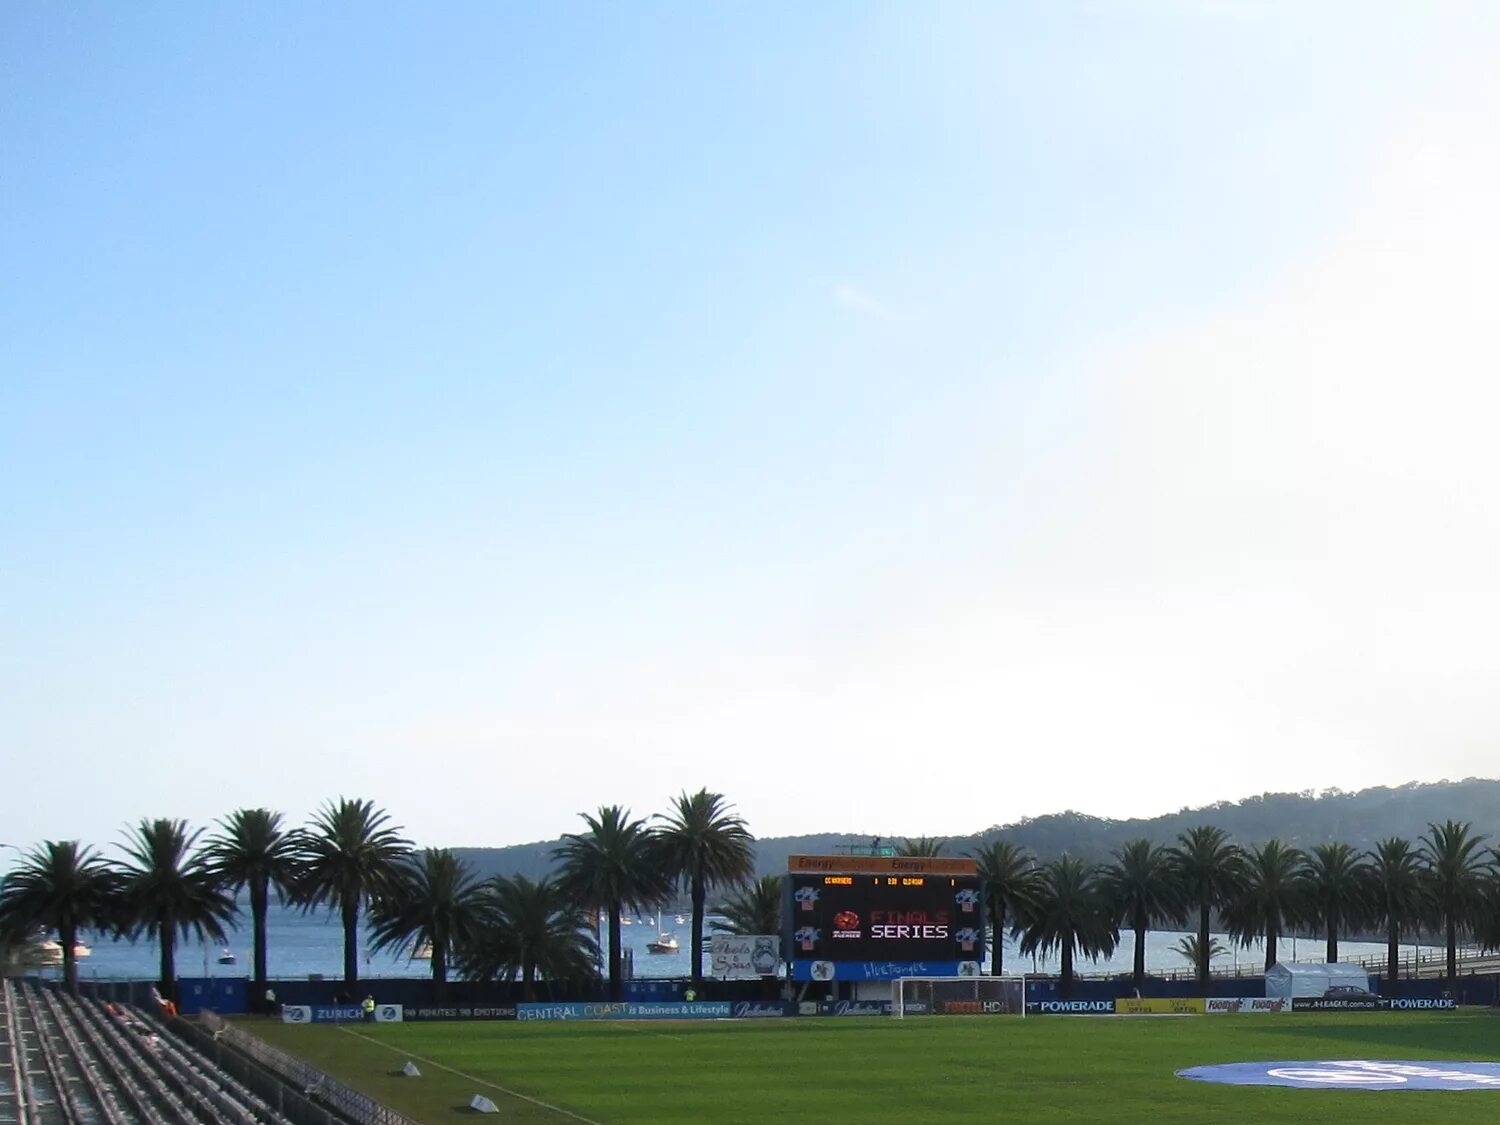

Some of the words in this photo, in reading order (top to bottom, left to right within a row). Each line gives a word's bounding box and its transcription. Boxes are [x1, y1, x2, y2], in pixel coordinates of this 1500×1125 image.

[871, 912, 949, 924] FINALS
[871, 925, 949, 938] SERIES
[1041, 1000, 1114, 1012] POWERADE
[1390, 998, 1455, 1010] POWERADE
[317, 1008, 364, 1019] ZURICH
[473, 1008, 516, 1016] EMOTIONS
[517, 1006, 581, 1020] CENTRAL
[584, 1002, 628, 1017] COAST
[629, 1007, 637, 1015] is
[638, 1005, 679, 1015] Business
[681, 1005, 688, 1014] &
[690, 1003, 730, 1016] Lifestyle
